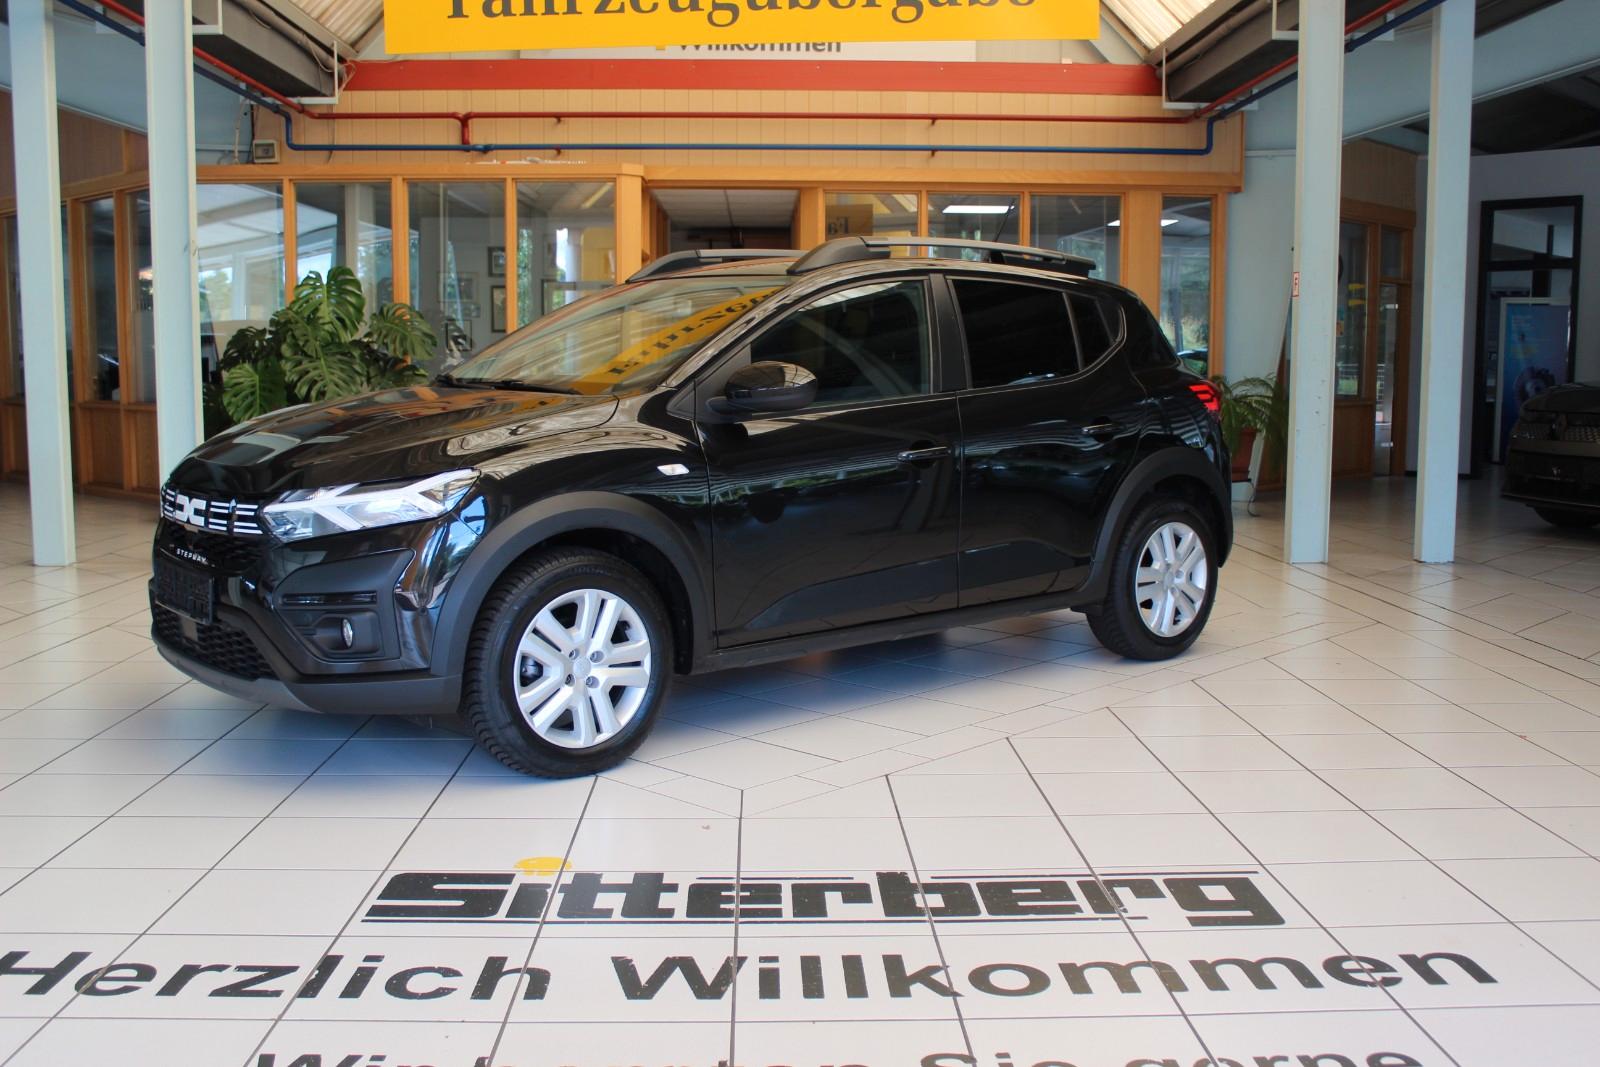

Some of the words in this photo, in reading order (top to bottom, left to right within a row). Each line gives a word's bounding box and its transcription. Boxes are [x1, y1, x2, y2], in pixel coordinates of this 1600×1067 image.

[374, 858, 1286, 927] Sitterberg
[0, 950, 552, 1001] Herzlich
[611, 950, 1499, 1000] Willkommen
